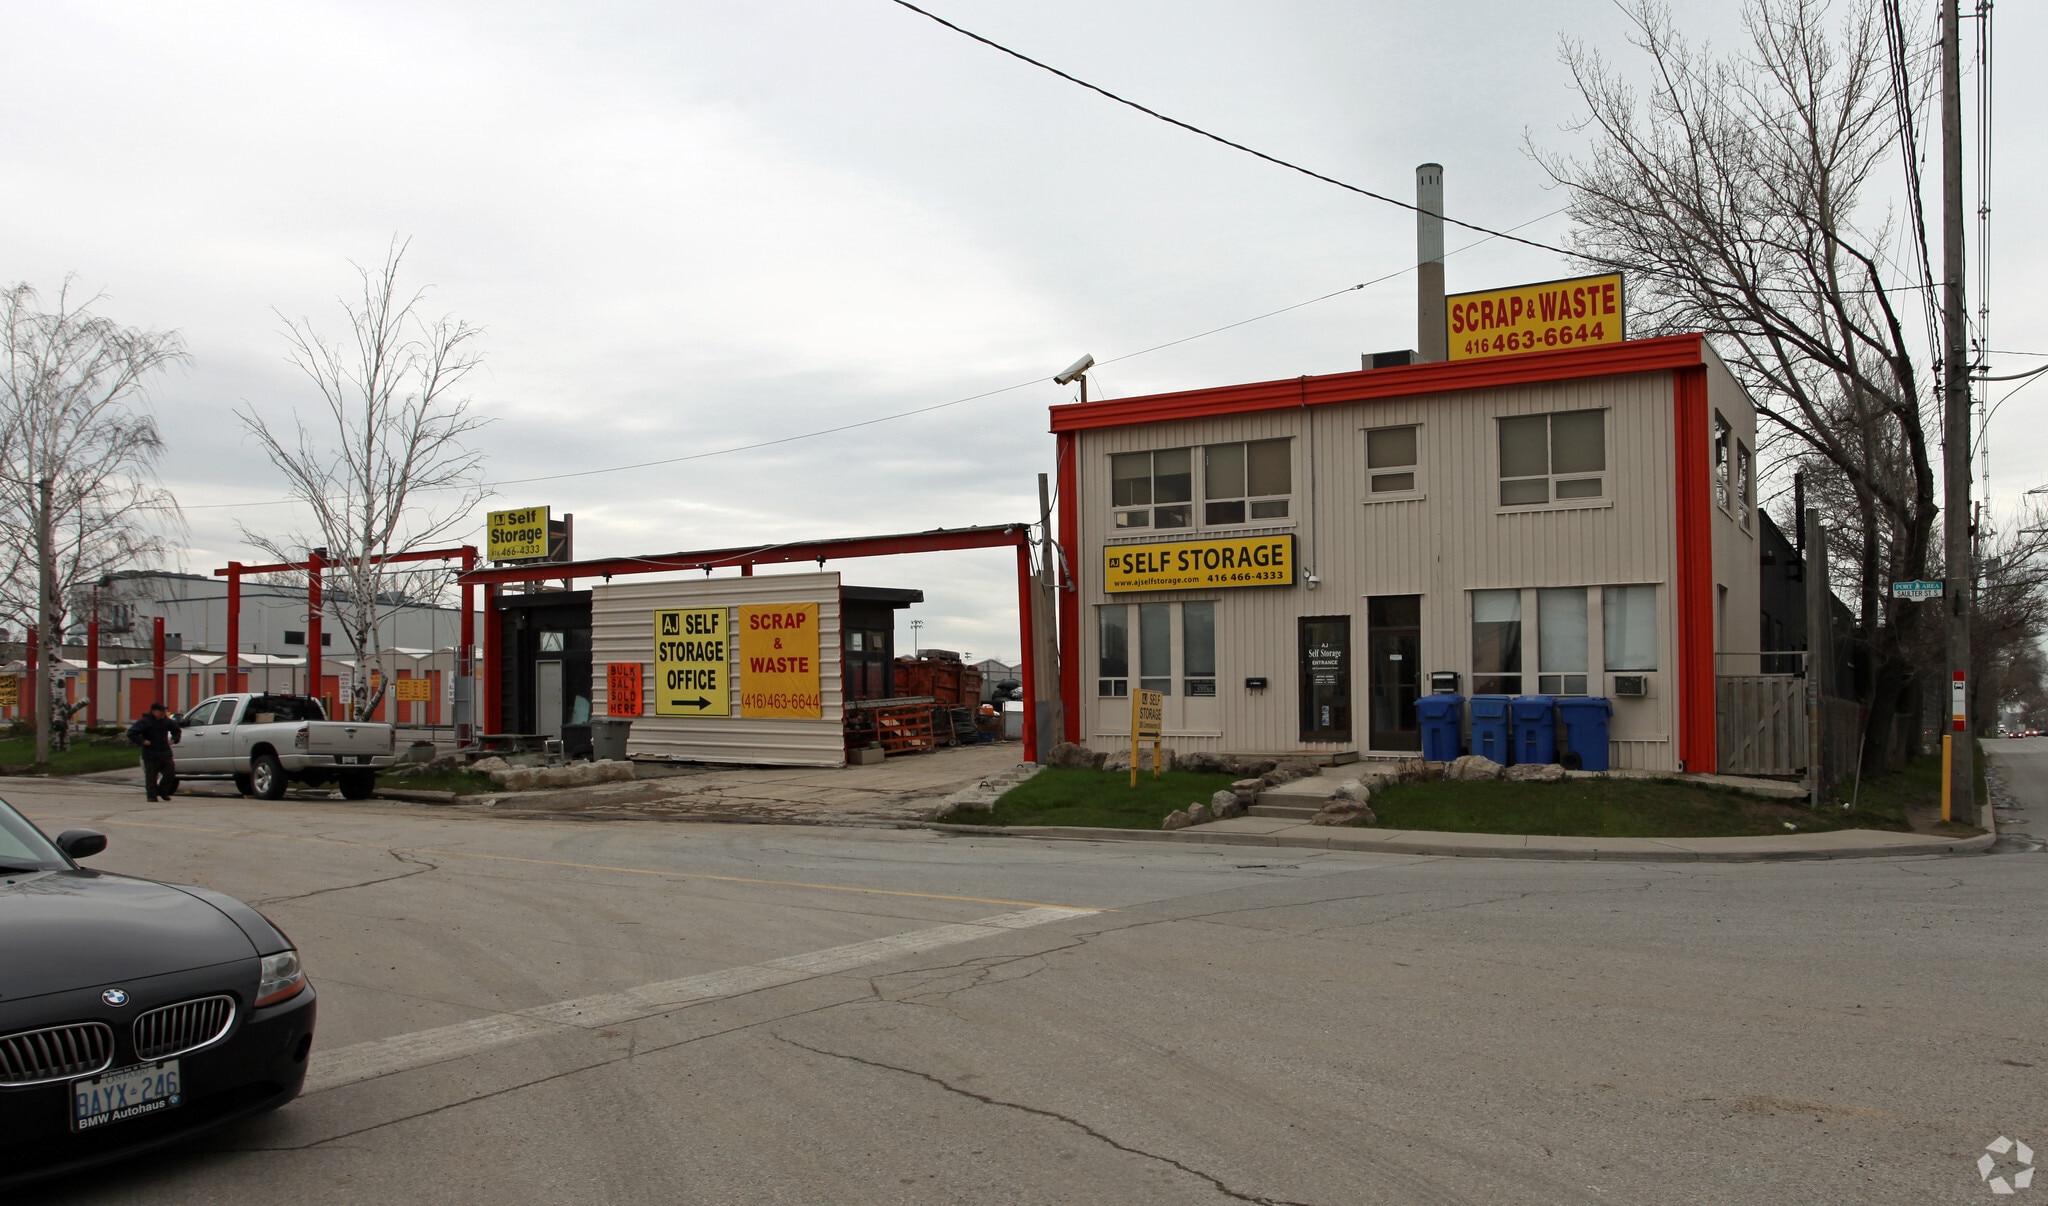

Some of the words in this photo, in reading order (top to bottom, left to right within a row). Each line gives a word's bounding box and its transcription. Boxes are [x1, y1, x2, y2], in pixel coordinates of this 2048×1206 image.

[1452, 296, 1522, 334] SCRAP
[1527, 298, 1536, 319] &
[1538, 284, 1616, 322] WASTE
[1465, 338, 1489, 354] 416
[1492, 322, 1604, 352] 463-6644
[508, 510, 536, 525] Self
[492, 528, 542, 544] Storage
[502, 544, 540, 556] 466-4333
[1110, 558, 1120, 568] AJ
[1123, 552, 1170, 574] SELF
[1178, 544, 1284, 570] STORAGE
[1114, 576, 1200, 586] www.ajselfstorage.com
[1208, 574, 1226, 582] 416
[1231, 572, 1284, 582] 466-4333
[663, 615, 680, 634] AJ
[686, 614, 719, 634] SELF
[750, 612, 806, 630] SCRAP
[774, 638, 782, 649] &
[660, 641, 724, 662] STORAGE
[1309, 649, 1320, 657] Self
[1320, 649, 1341, 659] Storage
[611, 666, 636, 676] BULK
[750, 657, 808, 673] WASTE
[611, 678, 636, 688] SALT
[668, 670, 716, 690] OFFICE
[611, 691, 636, 701] SOLD
[742, 694, 819, 709] (416)463-6644
[1150, 694, 1160, 705] SELF
[611, 704, 636, 714] HERE
[1140, 708, 1161, 720] STORAGE
[142, 1072, 177, 1102] 246
[79, 1112, 109, 1129] BMW
[112, 1100, 166, 1120] Autohaus
